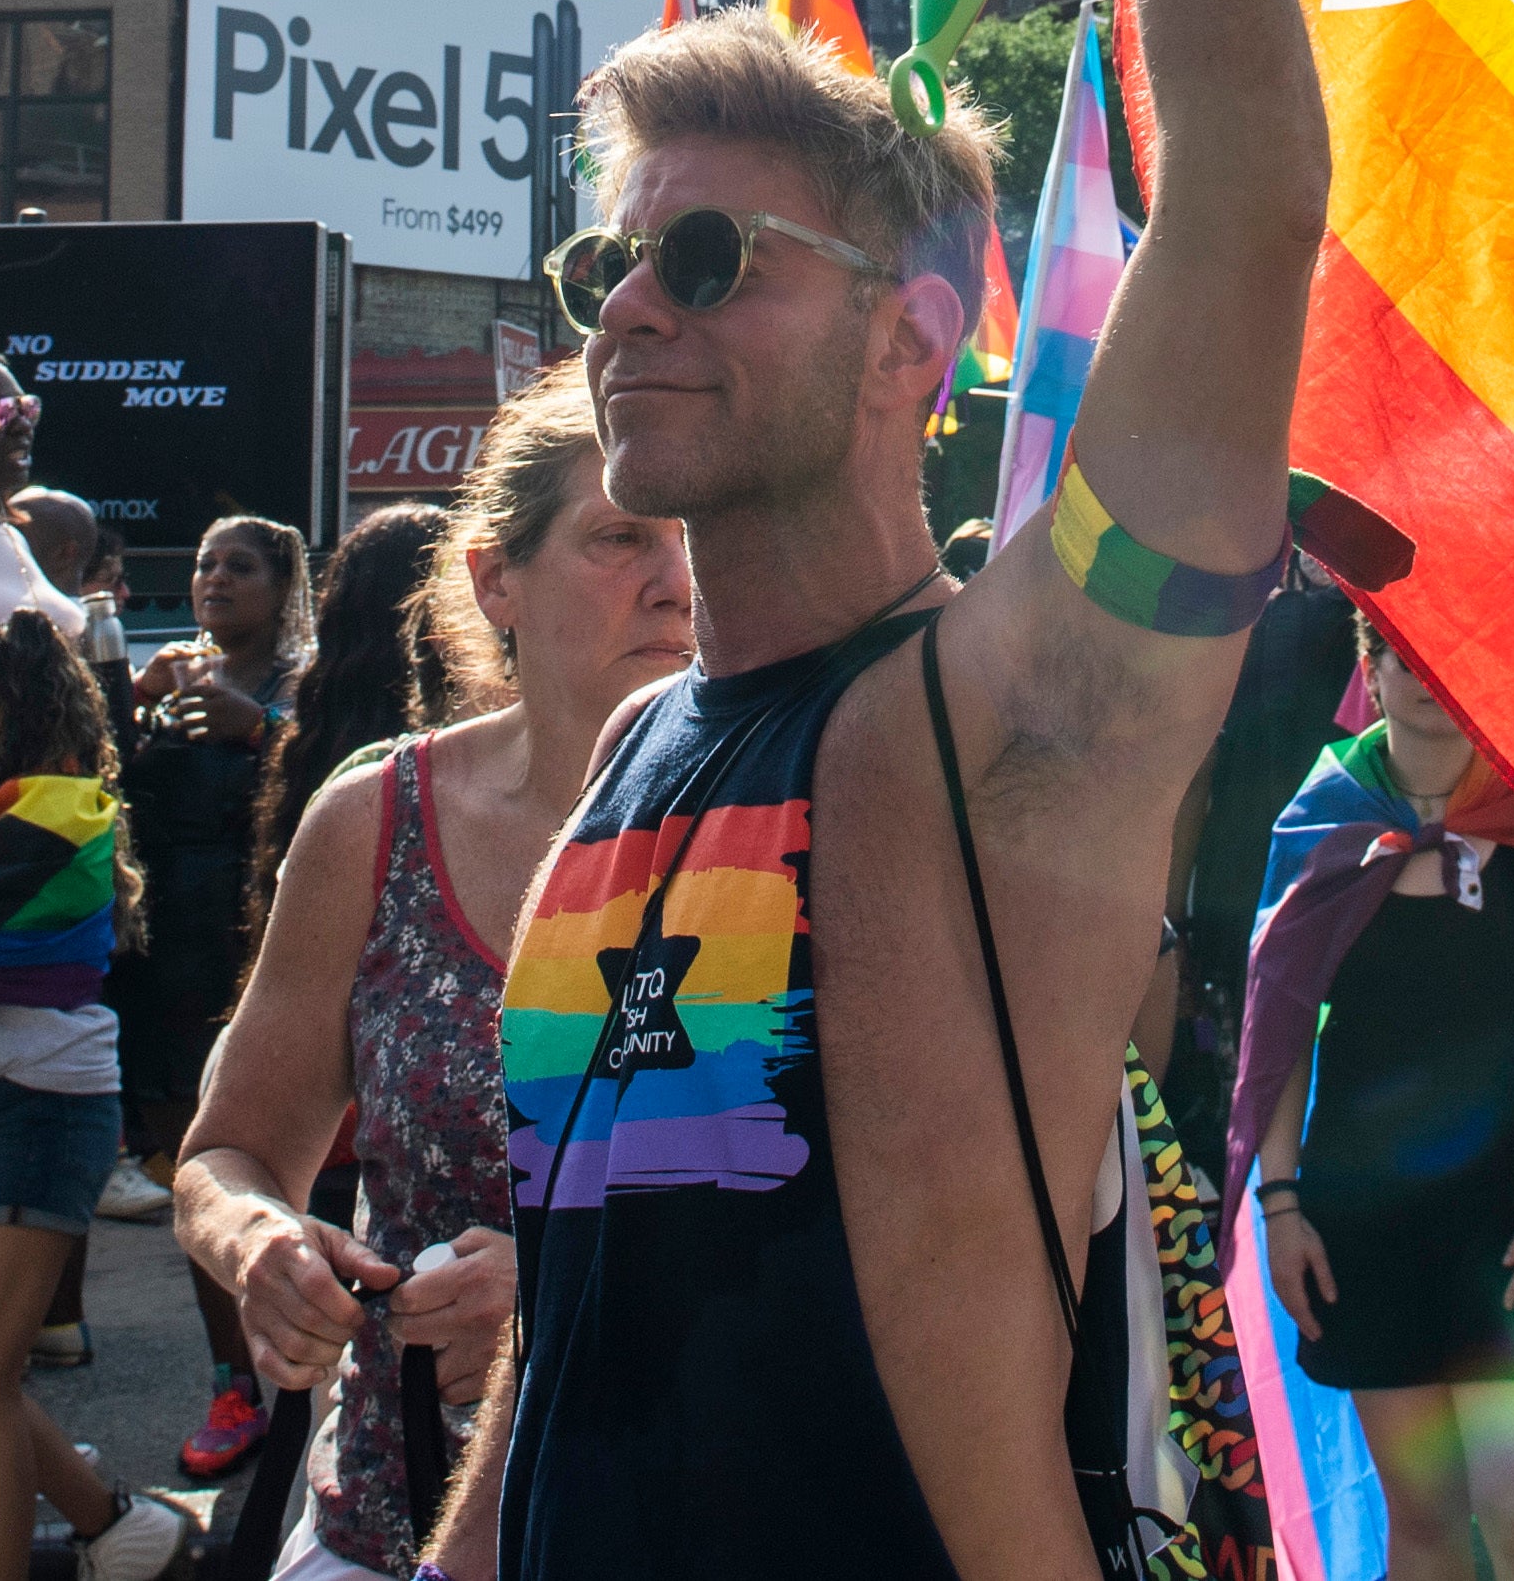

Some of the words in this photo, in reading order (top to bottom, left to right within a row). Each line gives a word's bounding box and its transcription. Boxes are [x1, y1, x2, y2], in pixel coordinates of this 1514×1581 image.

[213, 6, 461, 171] Pixel
[481, 51, 534, 181] 5
[383, 199, 440, 231] From
[447, 205, 503, 237] $499
[5, 334, 54, 356] NO
[34, 360, 185, 382] SUDDEN
[122, 386, 228, 407] MOVE
